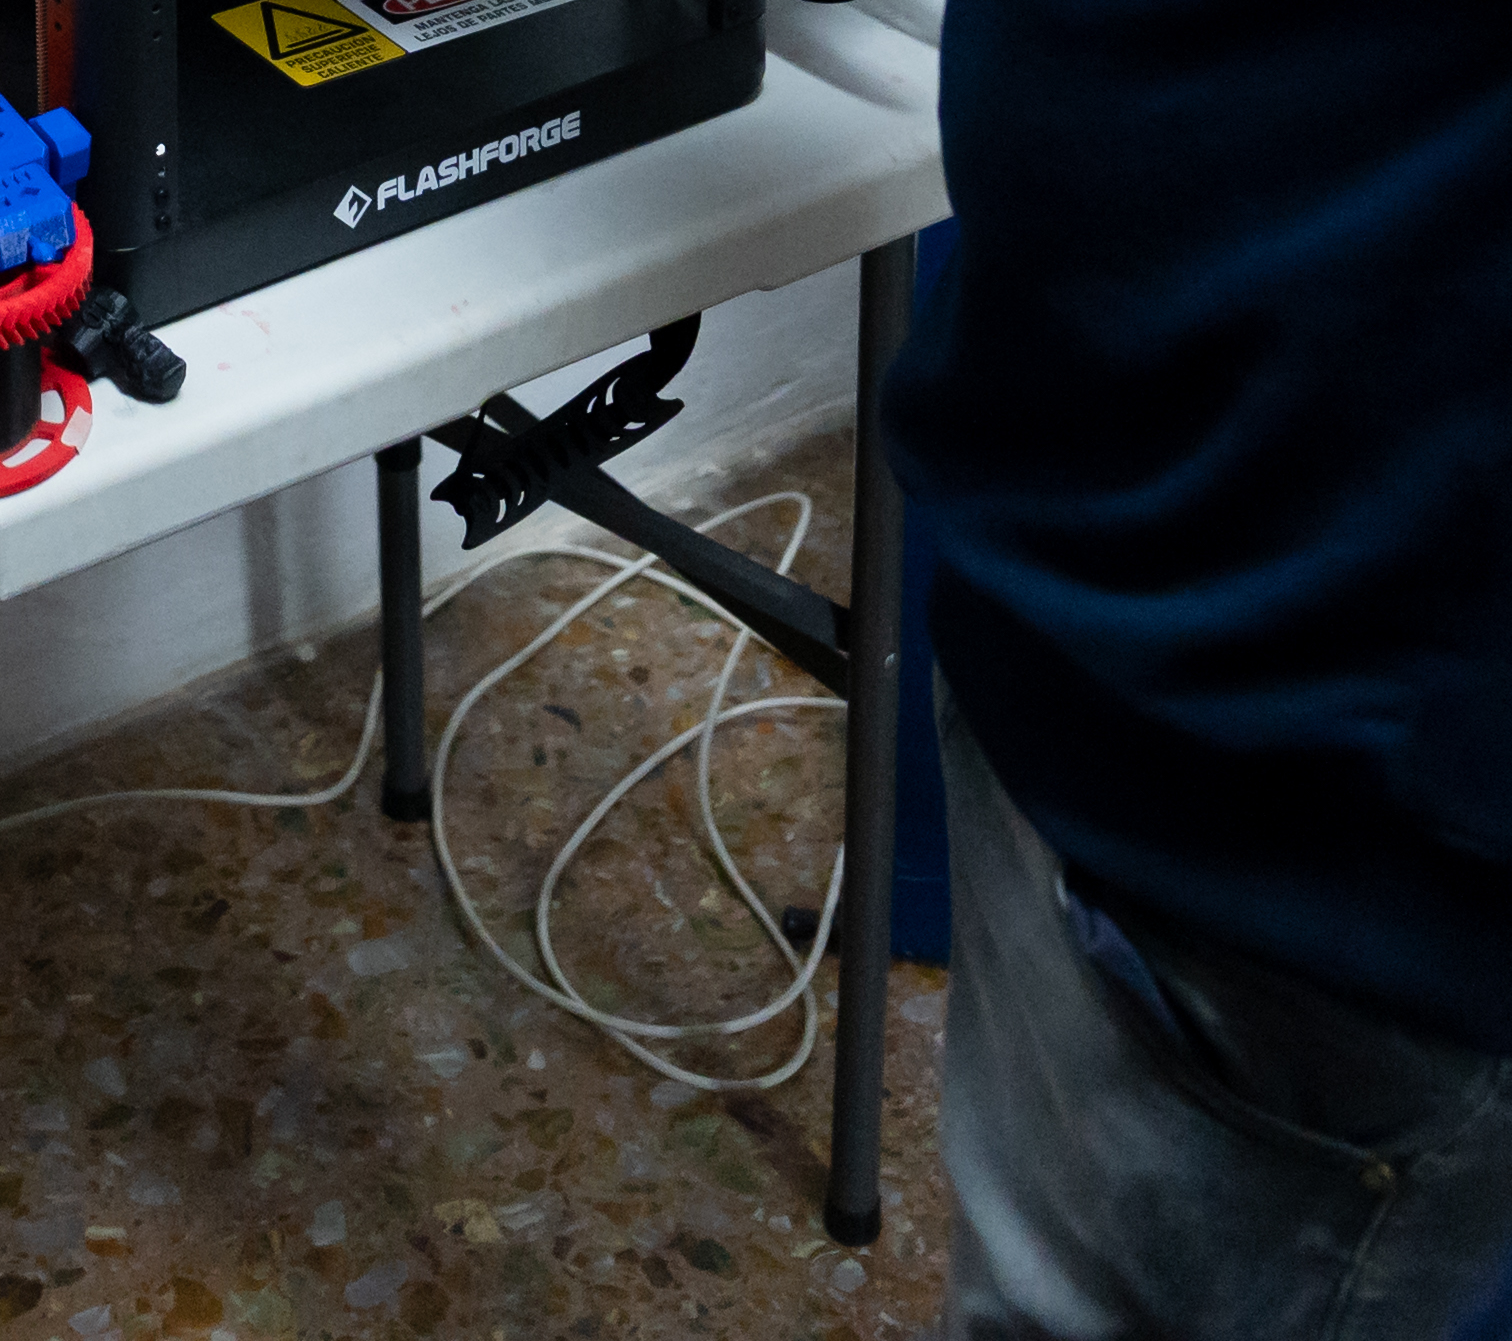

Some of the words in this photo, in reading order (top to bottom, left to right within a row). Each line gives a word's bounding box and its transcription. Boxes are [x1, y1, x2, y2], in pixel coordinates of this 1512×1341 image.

[413, 1, 490, 32] MANTENGA
[413, 25, 458, 43] LEJOS
[459, 17, 480, 34] DE
[475, 2, 529, 27] PARTES
[301, 43, 381, 74] SUPERFICIE
[316, 53, 385, 79] CALIENTE
[377, 110, 581, 211] FLASHFORGE
